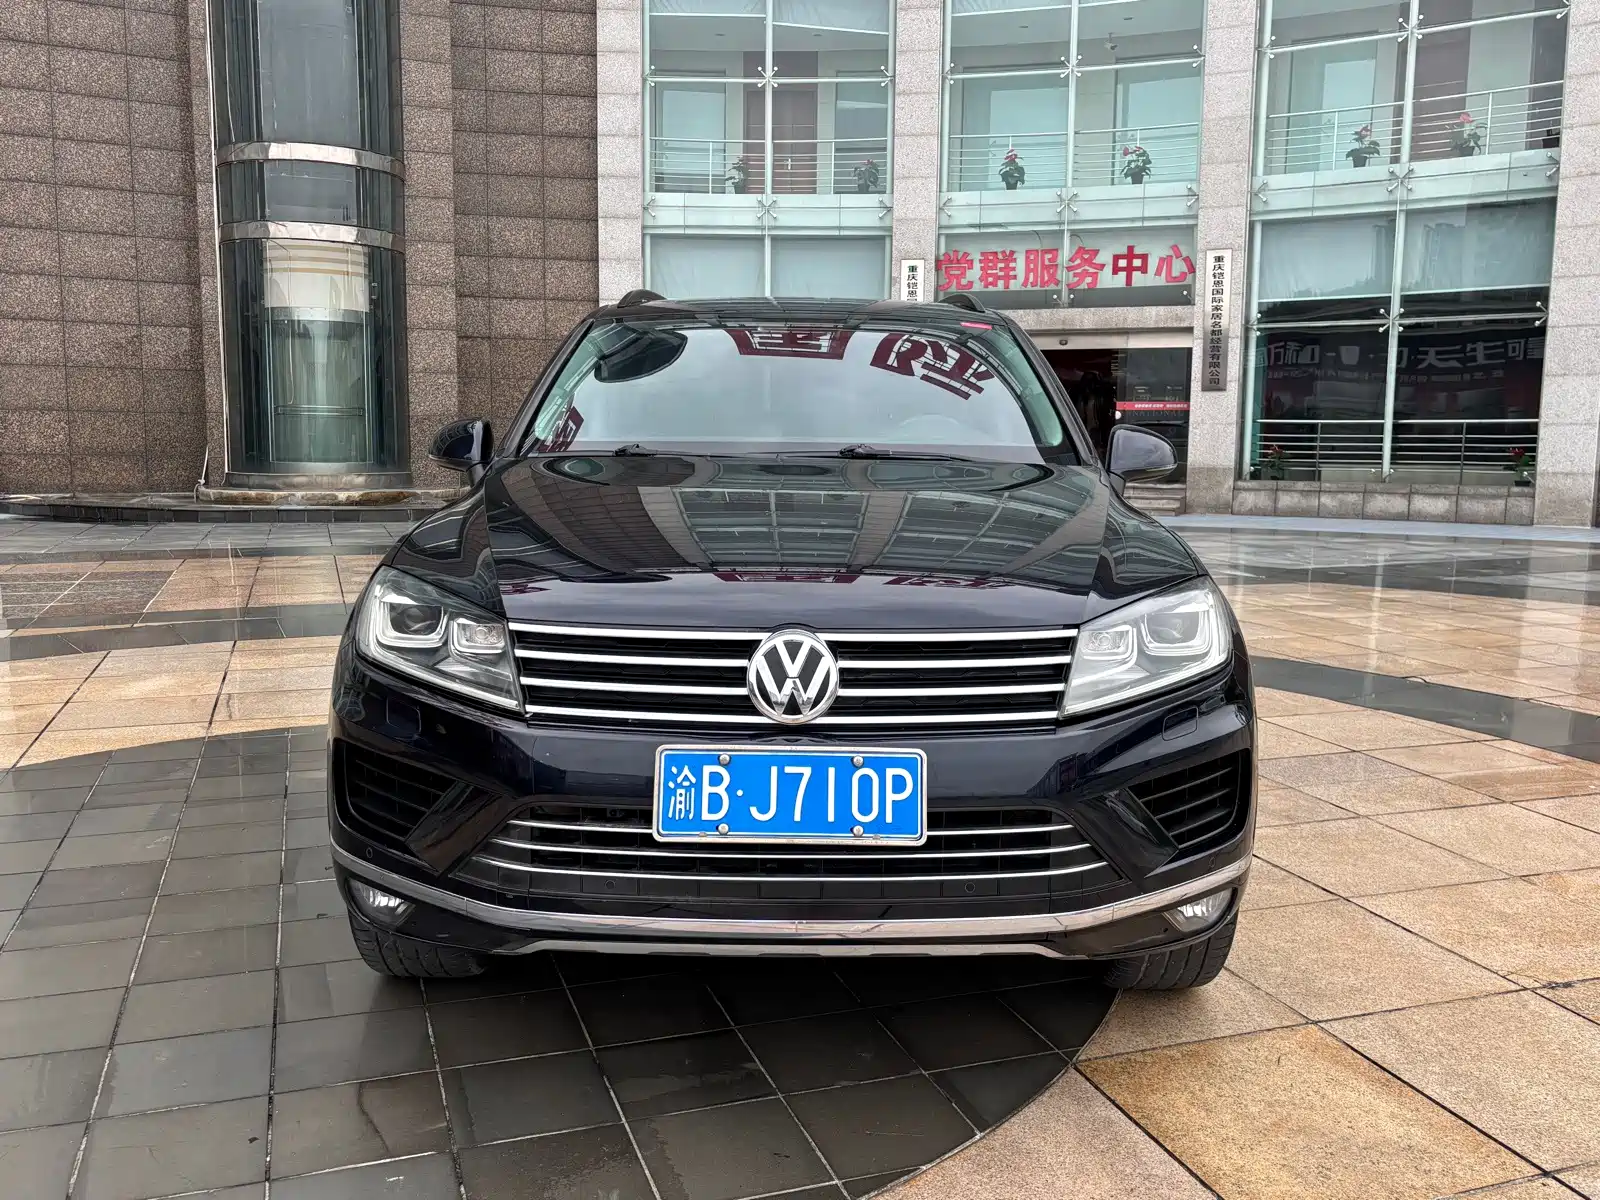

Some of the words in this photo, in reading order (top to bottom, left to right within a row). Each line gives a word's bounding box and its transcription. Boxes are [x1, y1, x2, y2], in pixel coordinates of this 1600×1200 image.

[936, 245, 1196, 291] 党群服务中心
[1208, 255, 1226, 385] 重庆铠恩国际家居名都经营有限公司
